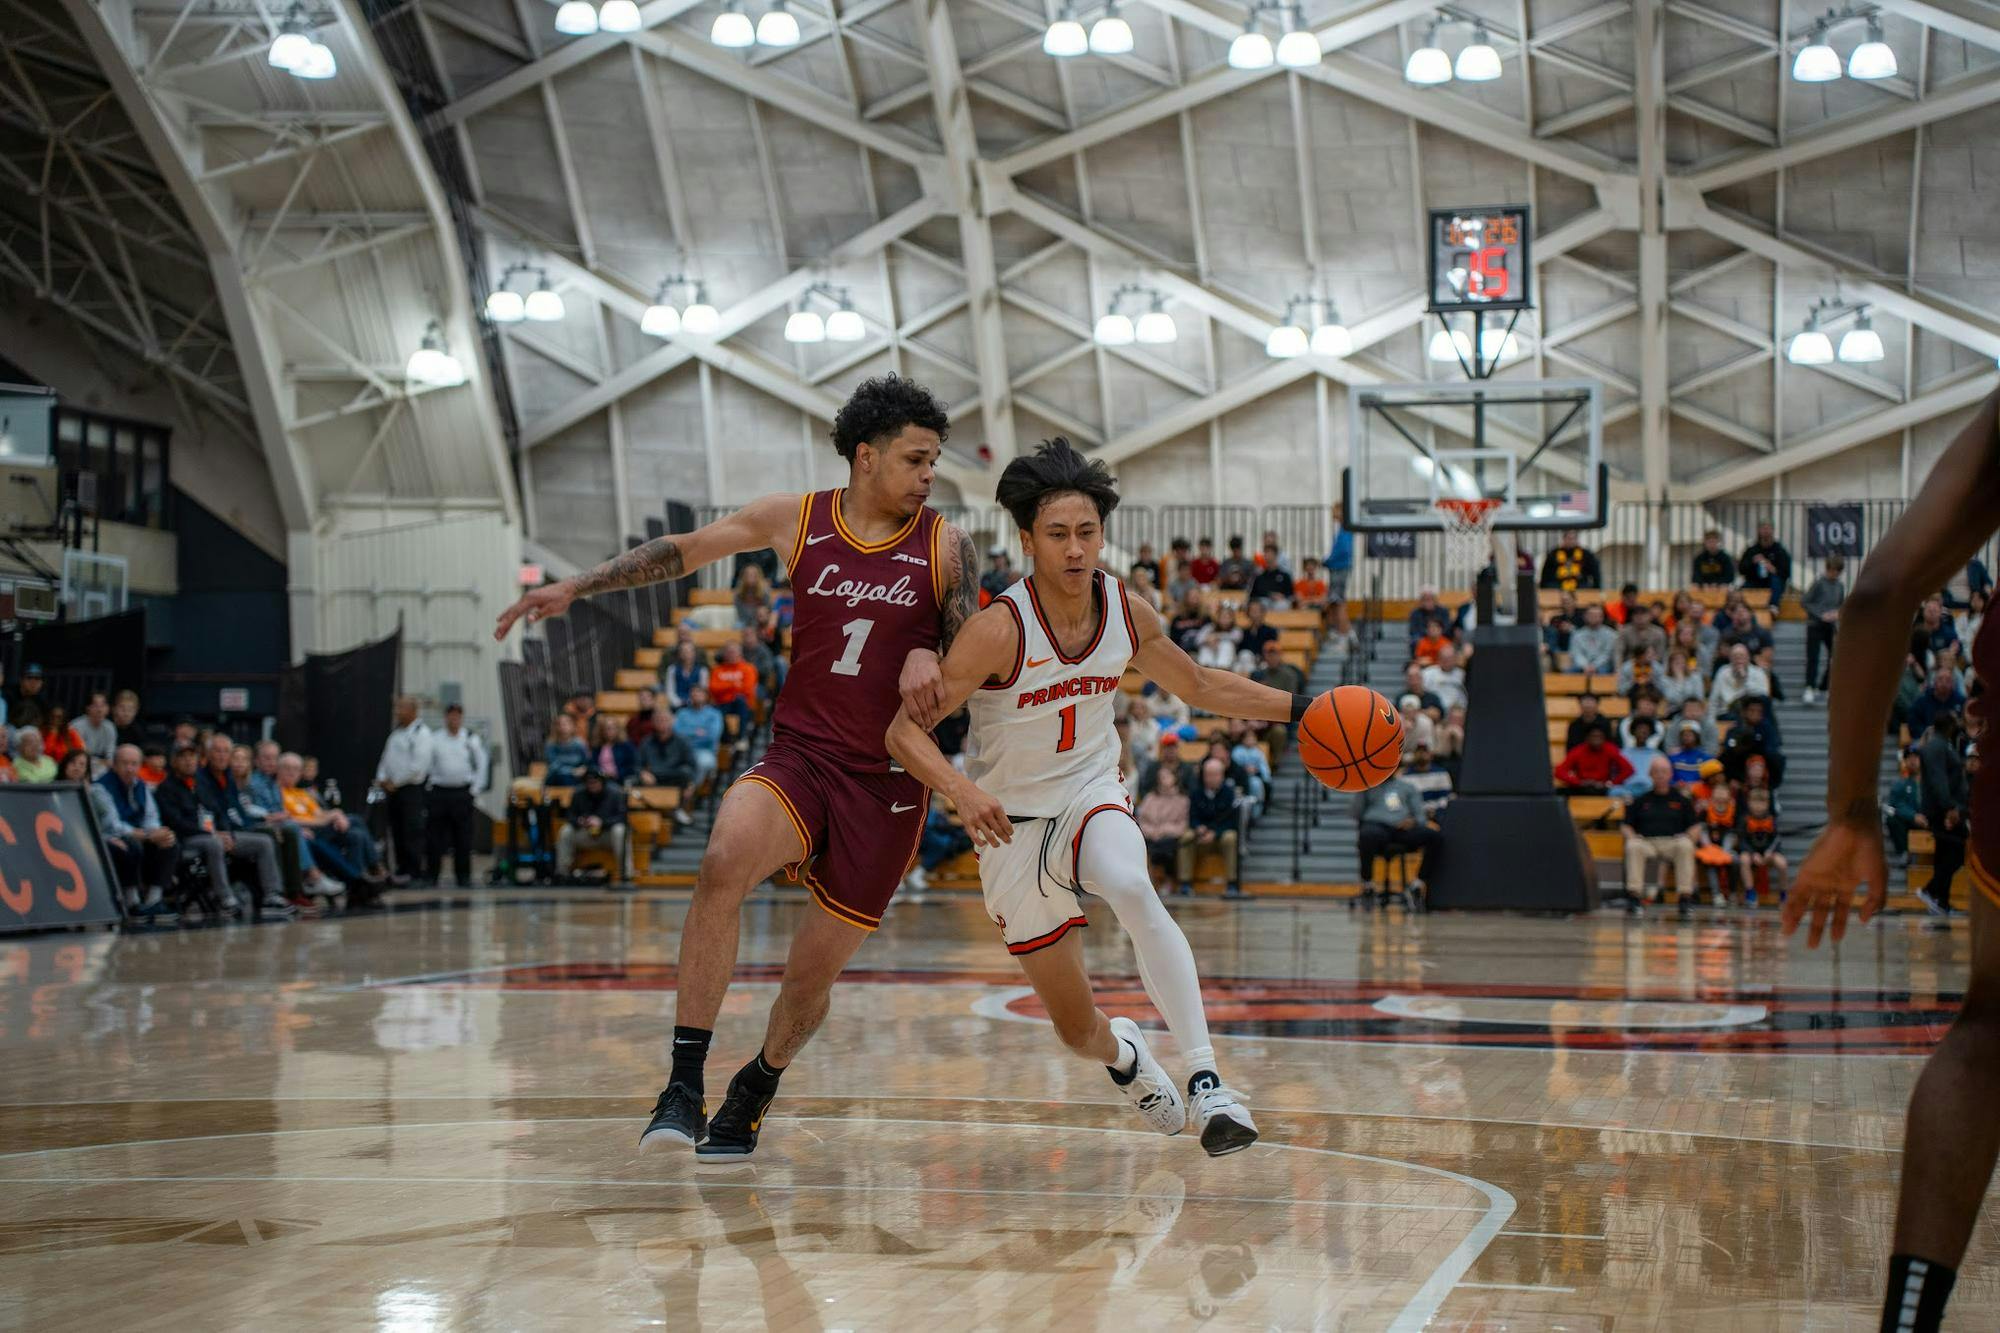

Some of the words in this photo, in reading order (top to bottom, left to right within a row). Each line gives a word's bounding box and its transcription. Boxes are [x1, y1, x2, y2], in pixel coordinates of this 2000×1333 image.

[1815, 521, 1857, 545] 103
[807, 564, 918, 608] Loyola
[830, 618, 875, 677] 1
[1017, 676, 1121, 709] PRINCETON
[1056, 703, 1077, 754] 1
